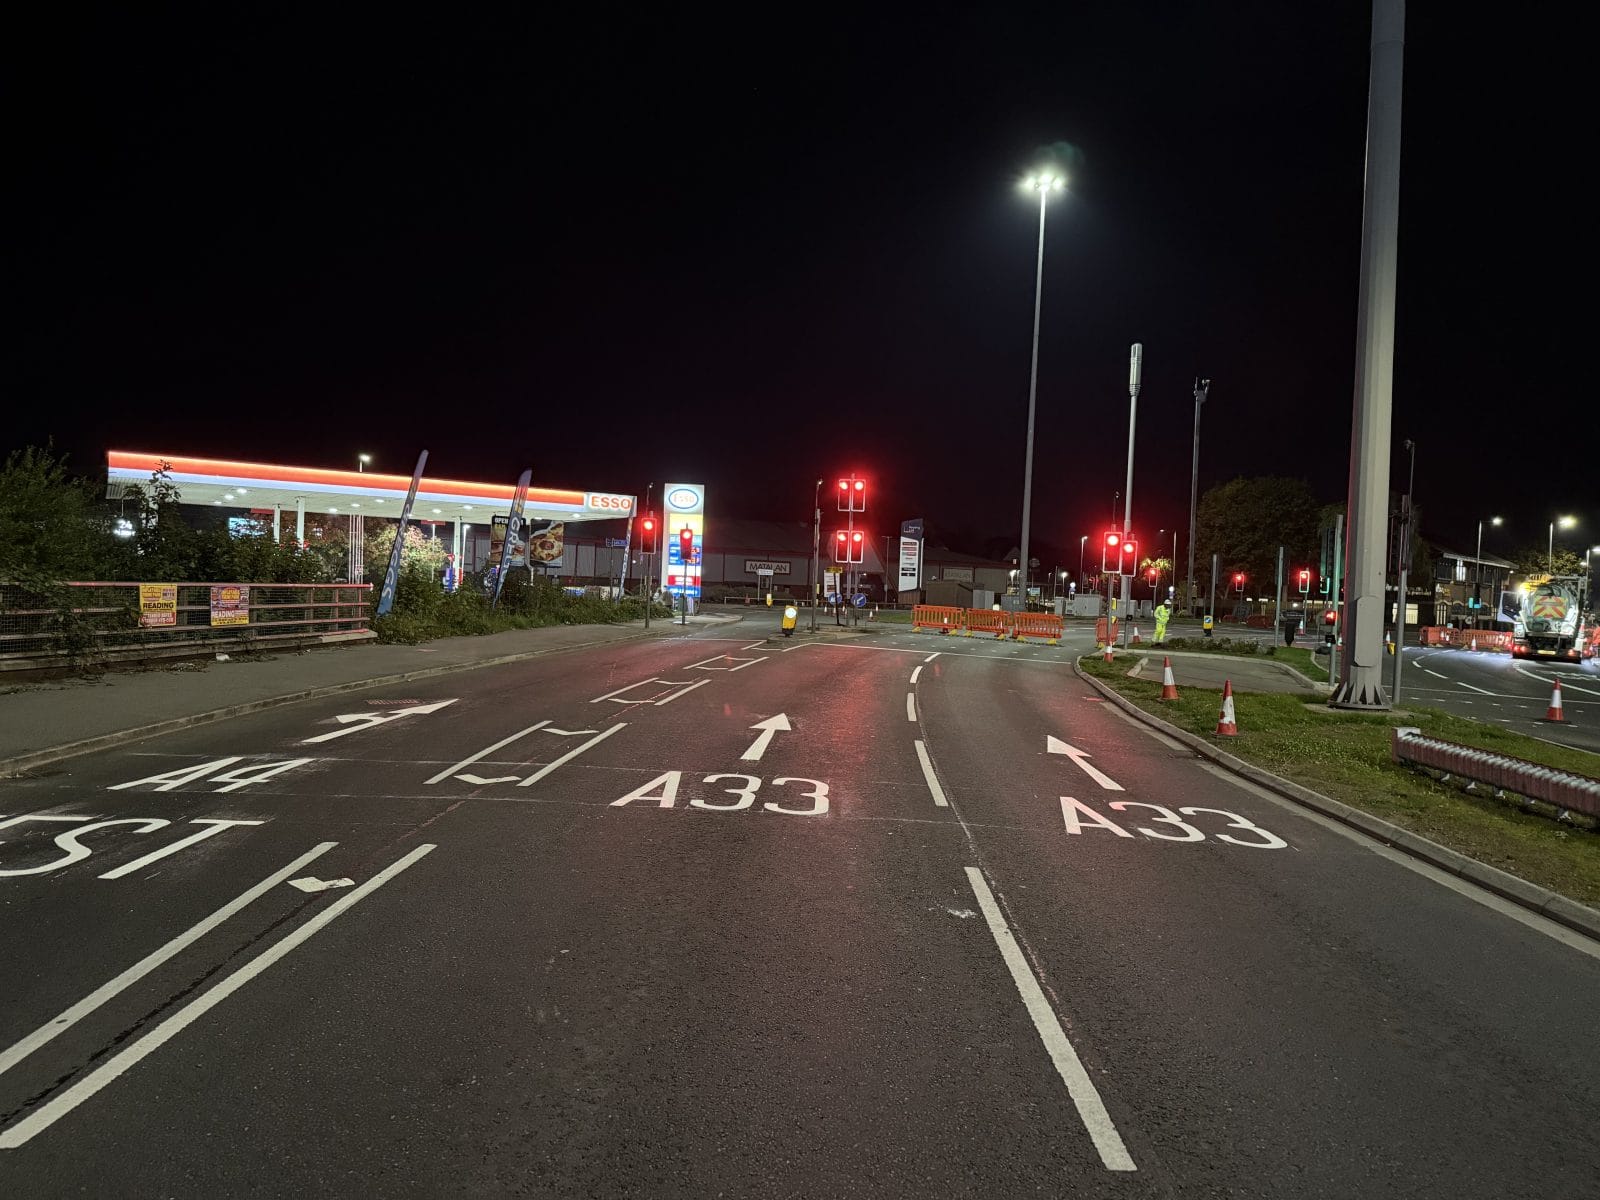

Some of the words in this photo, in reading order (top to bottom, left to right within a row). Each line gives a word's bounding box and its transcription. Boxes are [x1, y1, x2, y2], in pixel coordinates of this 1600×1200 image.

[590, 495, 632, 510] ESSO
[107, 756, 317, 793] A4
[609, 770, 832, 818] A33
[0, 812, 266, 881] EST
[1060, 795, 1290, 850] A33
